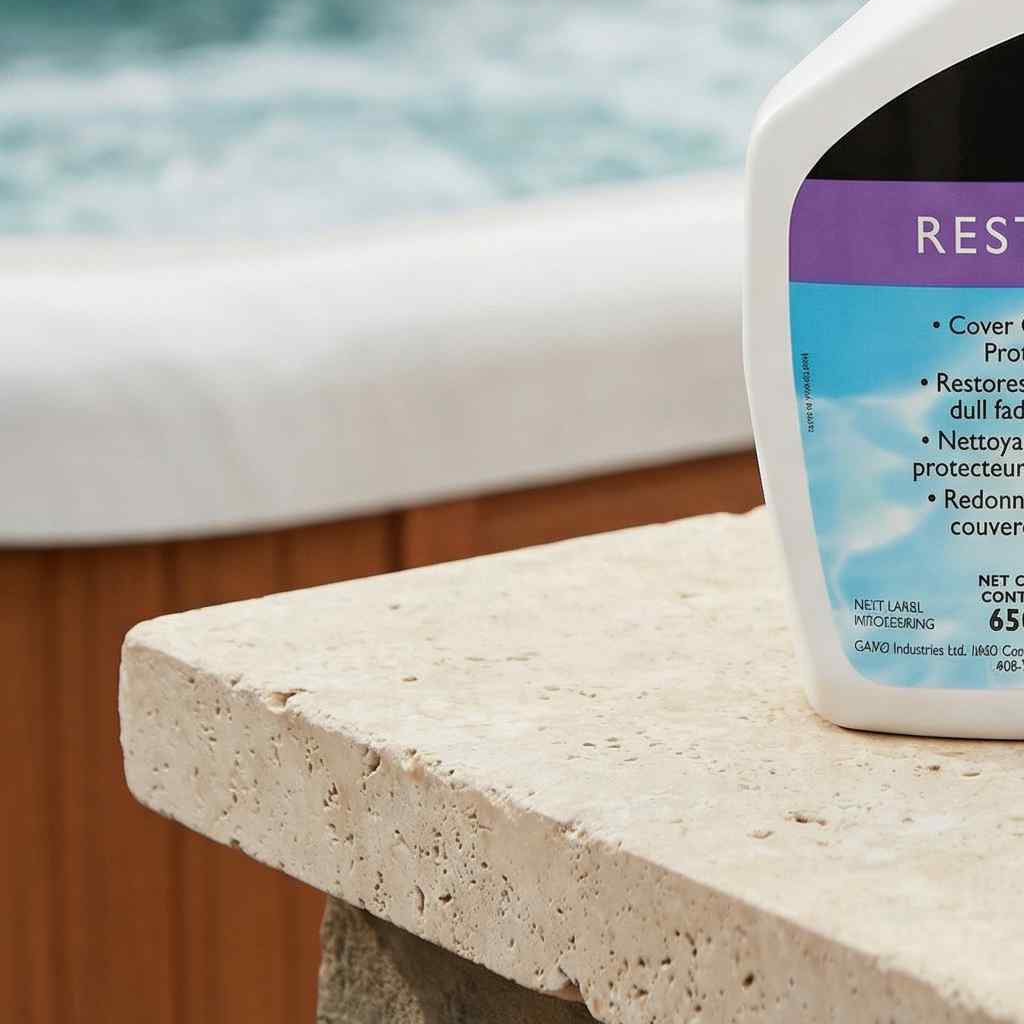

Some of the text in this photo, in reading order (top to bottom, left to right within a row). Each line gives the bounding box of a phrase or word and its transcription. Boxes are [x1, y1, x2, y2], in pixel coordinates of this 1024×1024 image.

[949, 316, 1014, 335] Cover
[951, 399, 986, 419] dull
[979, 575, 1010, 587] NET
[894, 641, 944, 656] Industries
